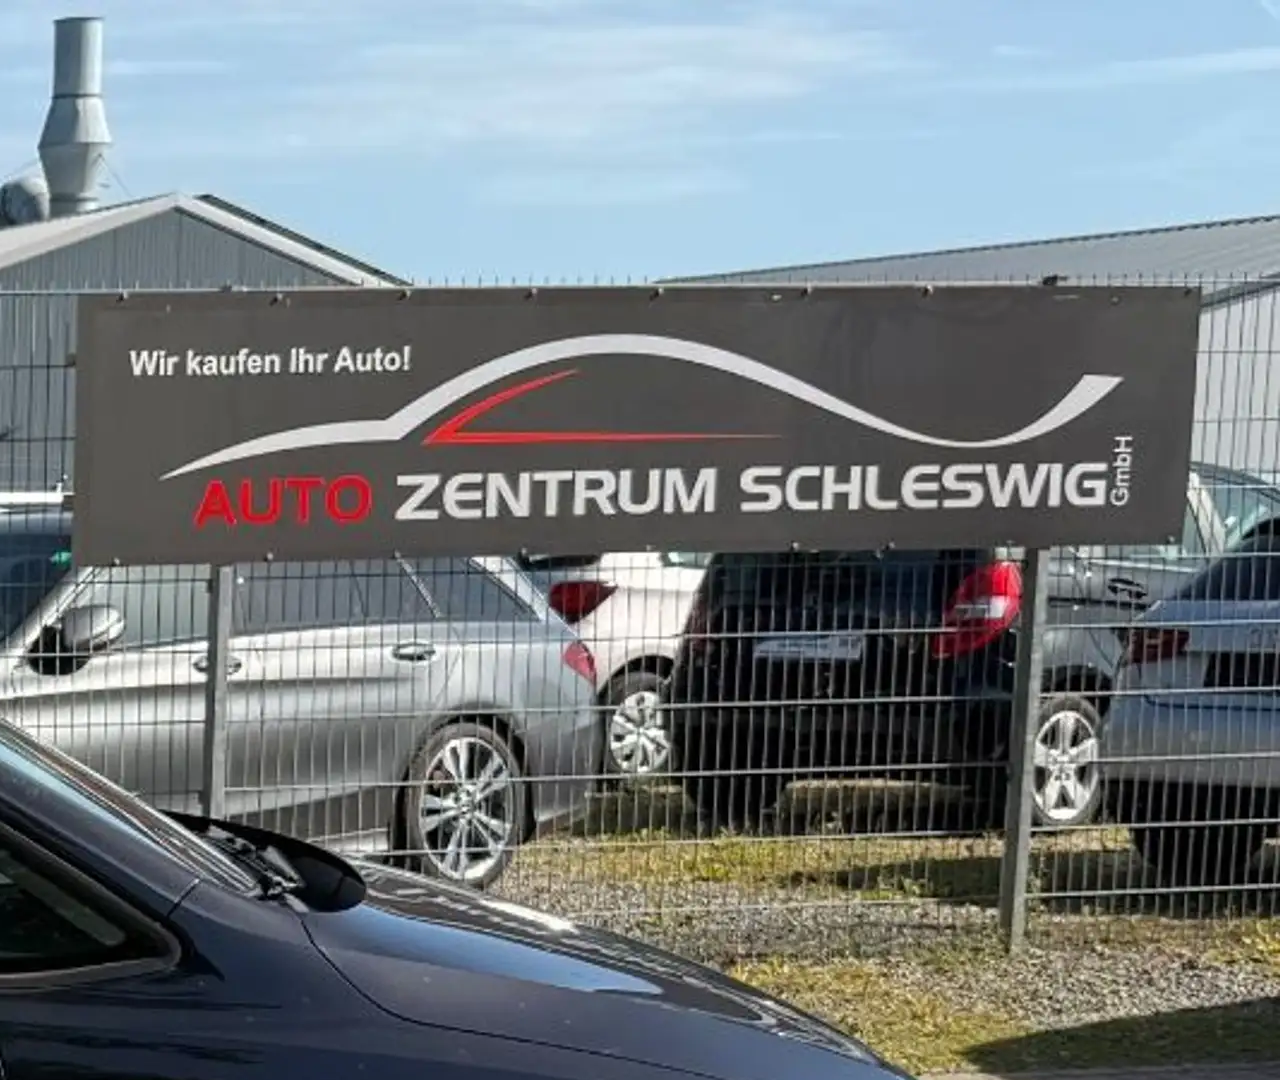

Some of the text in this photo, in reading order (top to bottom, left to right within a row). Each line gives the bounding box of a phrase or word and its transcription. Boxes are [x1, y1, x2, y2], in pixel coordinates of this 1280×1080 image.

[129, 346, 411, 376] Wir kaufen Ihr Auto!
[194, 462, 1108, 528] AUTO ZENTRUM SCHLESWIG
[1111, 436, 1133, 506] GmbH
